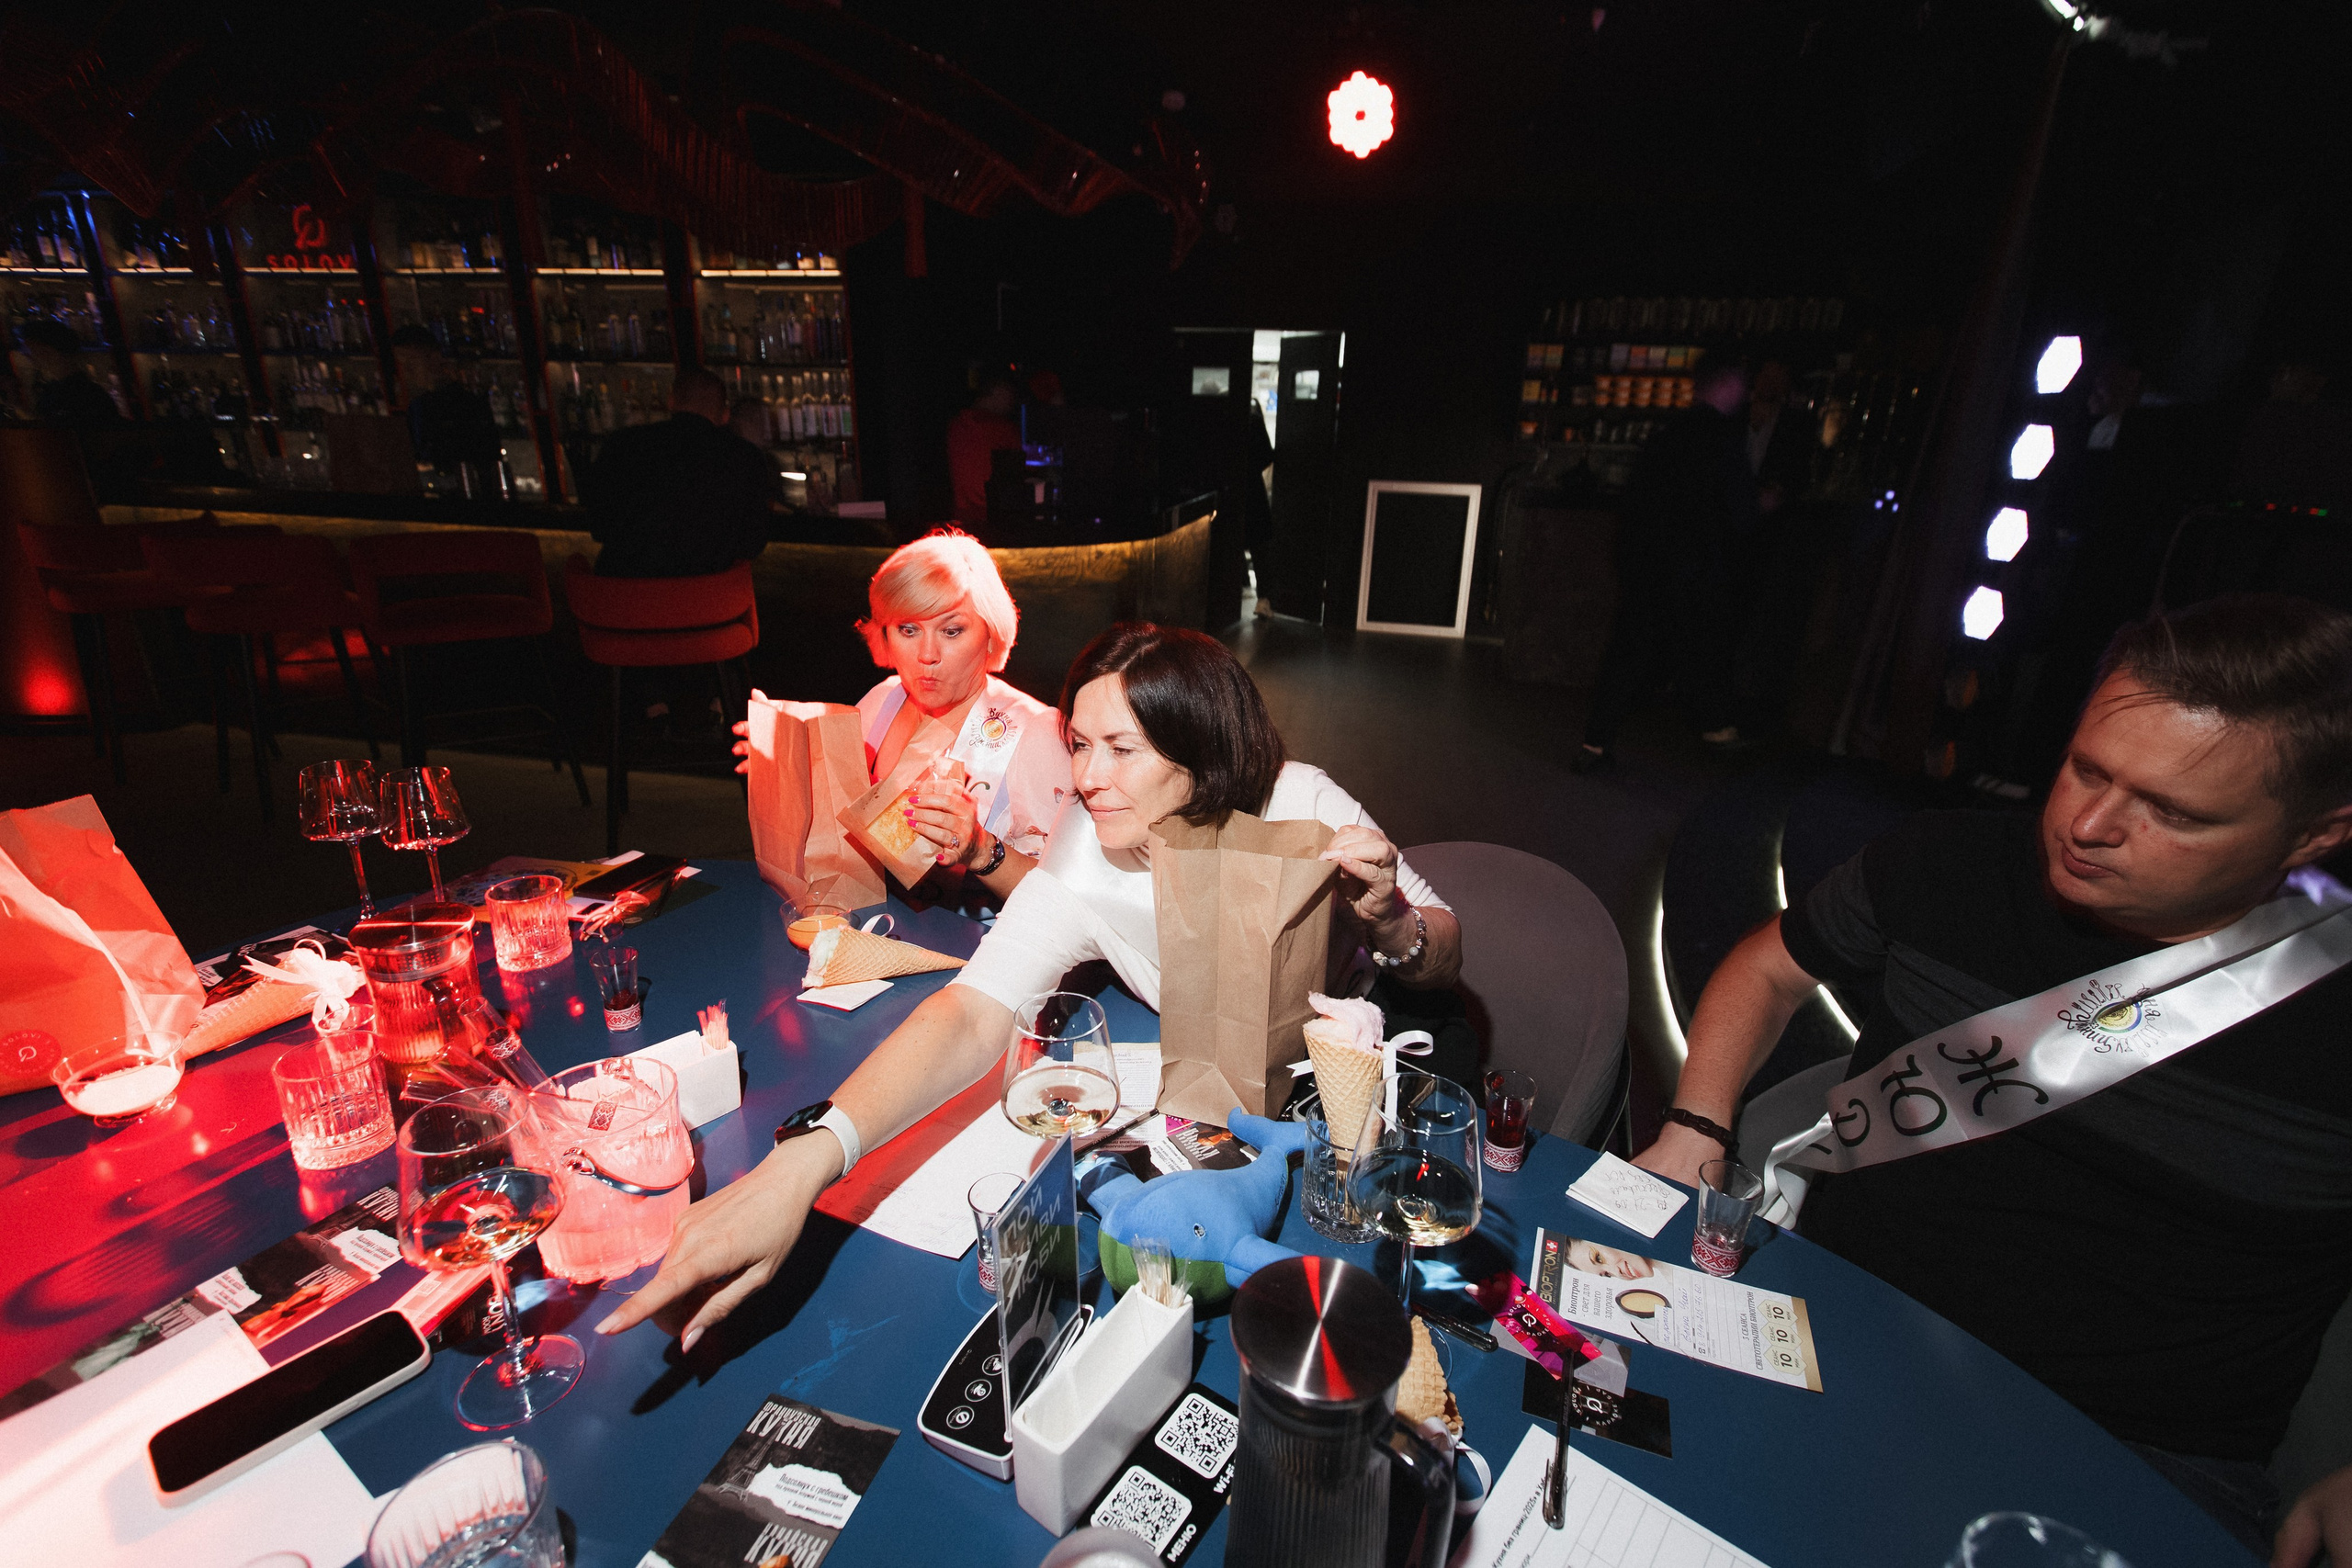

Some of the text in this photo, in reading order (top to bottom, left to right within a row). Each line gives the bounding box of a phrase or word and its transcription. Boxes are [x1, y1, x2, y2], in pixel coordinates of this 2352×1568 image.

[1002, 1184, 1043, 1251] ПОЙ
[1539, 1250, 1560, 1303] BIOPTRON
[1567, 1277, 1580, 1314] Биоптрон
[1581, 1298, 1589, 1313] свет
[1593, 1290, 1601, 1316] вашего
[1605, 1287, 1615, 1319] здоровья
[1741, 1313, 1749, 1337] СЕАНСА
[1772, 1306, 1785, 1320] 10
[1747, 1292, 1764, 1371] СВЕТОТЕРАПИИ БИОПТРОН
[1776, 1329, 1789, 1343] 10
[1780, 1353, 1792, 1368] 10
[763, 1401, 822, 1427] ФРАНЦУЗСКАЯ
[745, 1409, 817, 1450] КУХНЯ
[779, 1472, 810, 1491] Подсолнух
[1167, 1524, 1197, 1562] МЕНЮ
[1503, 1536, 1515, 1551] без
